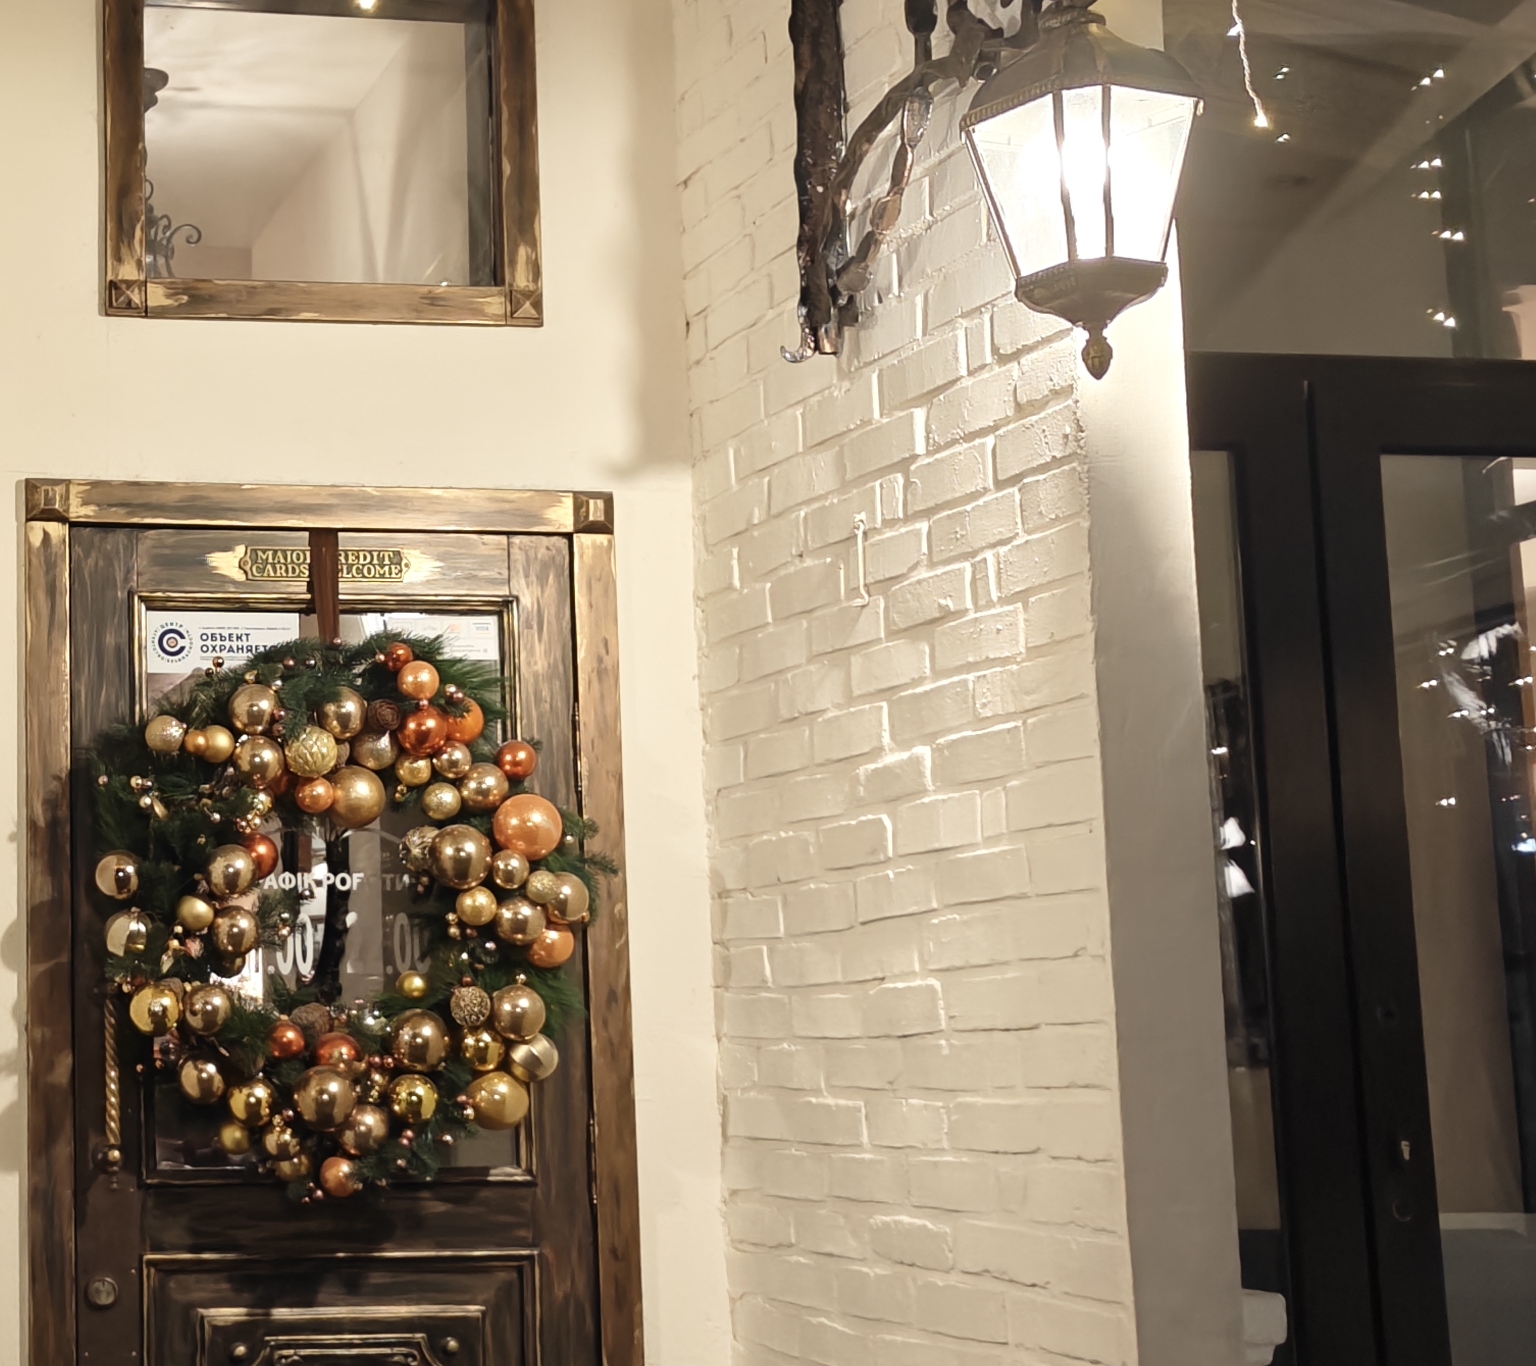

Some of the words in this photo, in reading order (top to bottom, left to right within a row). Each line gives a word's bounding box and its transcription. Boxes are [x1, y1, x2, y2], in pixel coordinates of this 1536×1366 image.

[338, 550, 394, 565] REDIT
[252, 563, 309, 578] CARDS
[338, 564, 401, 578] LCOME
[199, 632, 251, 643] ОБЪЕКТ
[199, 643, 277, 654] ОХРАНЯЕТ
[258, 871, 316, 891] АФІК
